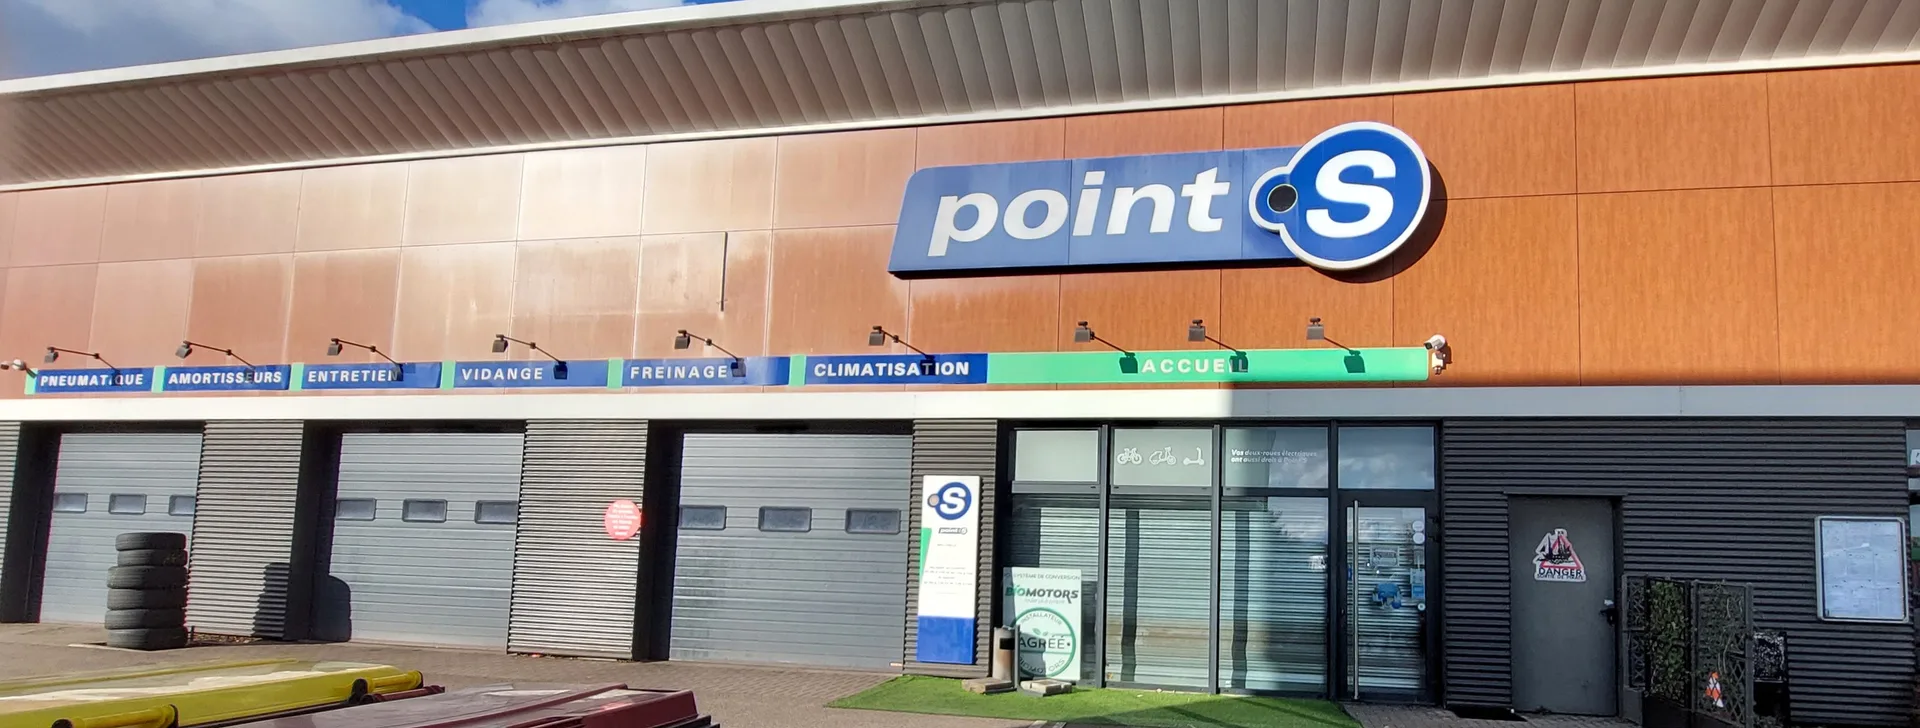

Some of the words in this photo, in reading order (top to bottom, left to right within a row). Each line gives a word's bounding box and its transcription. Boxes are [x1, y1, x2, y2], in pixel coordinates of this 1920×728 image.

[927, 166, 1232, 257] point
[1305, 148, 1397, 239] S
[629, 364, 728, 379] FREINAGE
[814, 361, 970, 377] CLIMATISATION
[1141, 357, 1249, 374] ACCUEIL
[40, 373, 145, 387] PNEUMATIQUE
[167, 370, 283, 385] AMORTISSEURS
[307, 369, 399, 383] ENTRETIEN
[461, 367, 544, 381] VIDANGE
[1231, 448, 1244, 456] Vos
[939, 486, 967, 515] S
[1538, 567, 1583, 577] DANGER
[1020, 635, 1065, 650] AGRÉÉ
